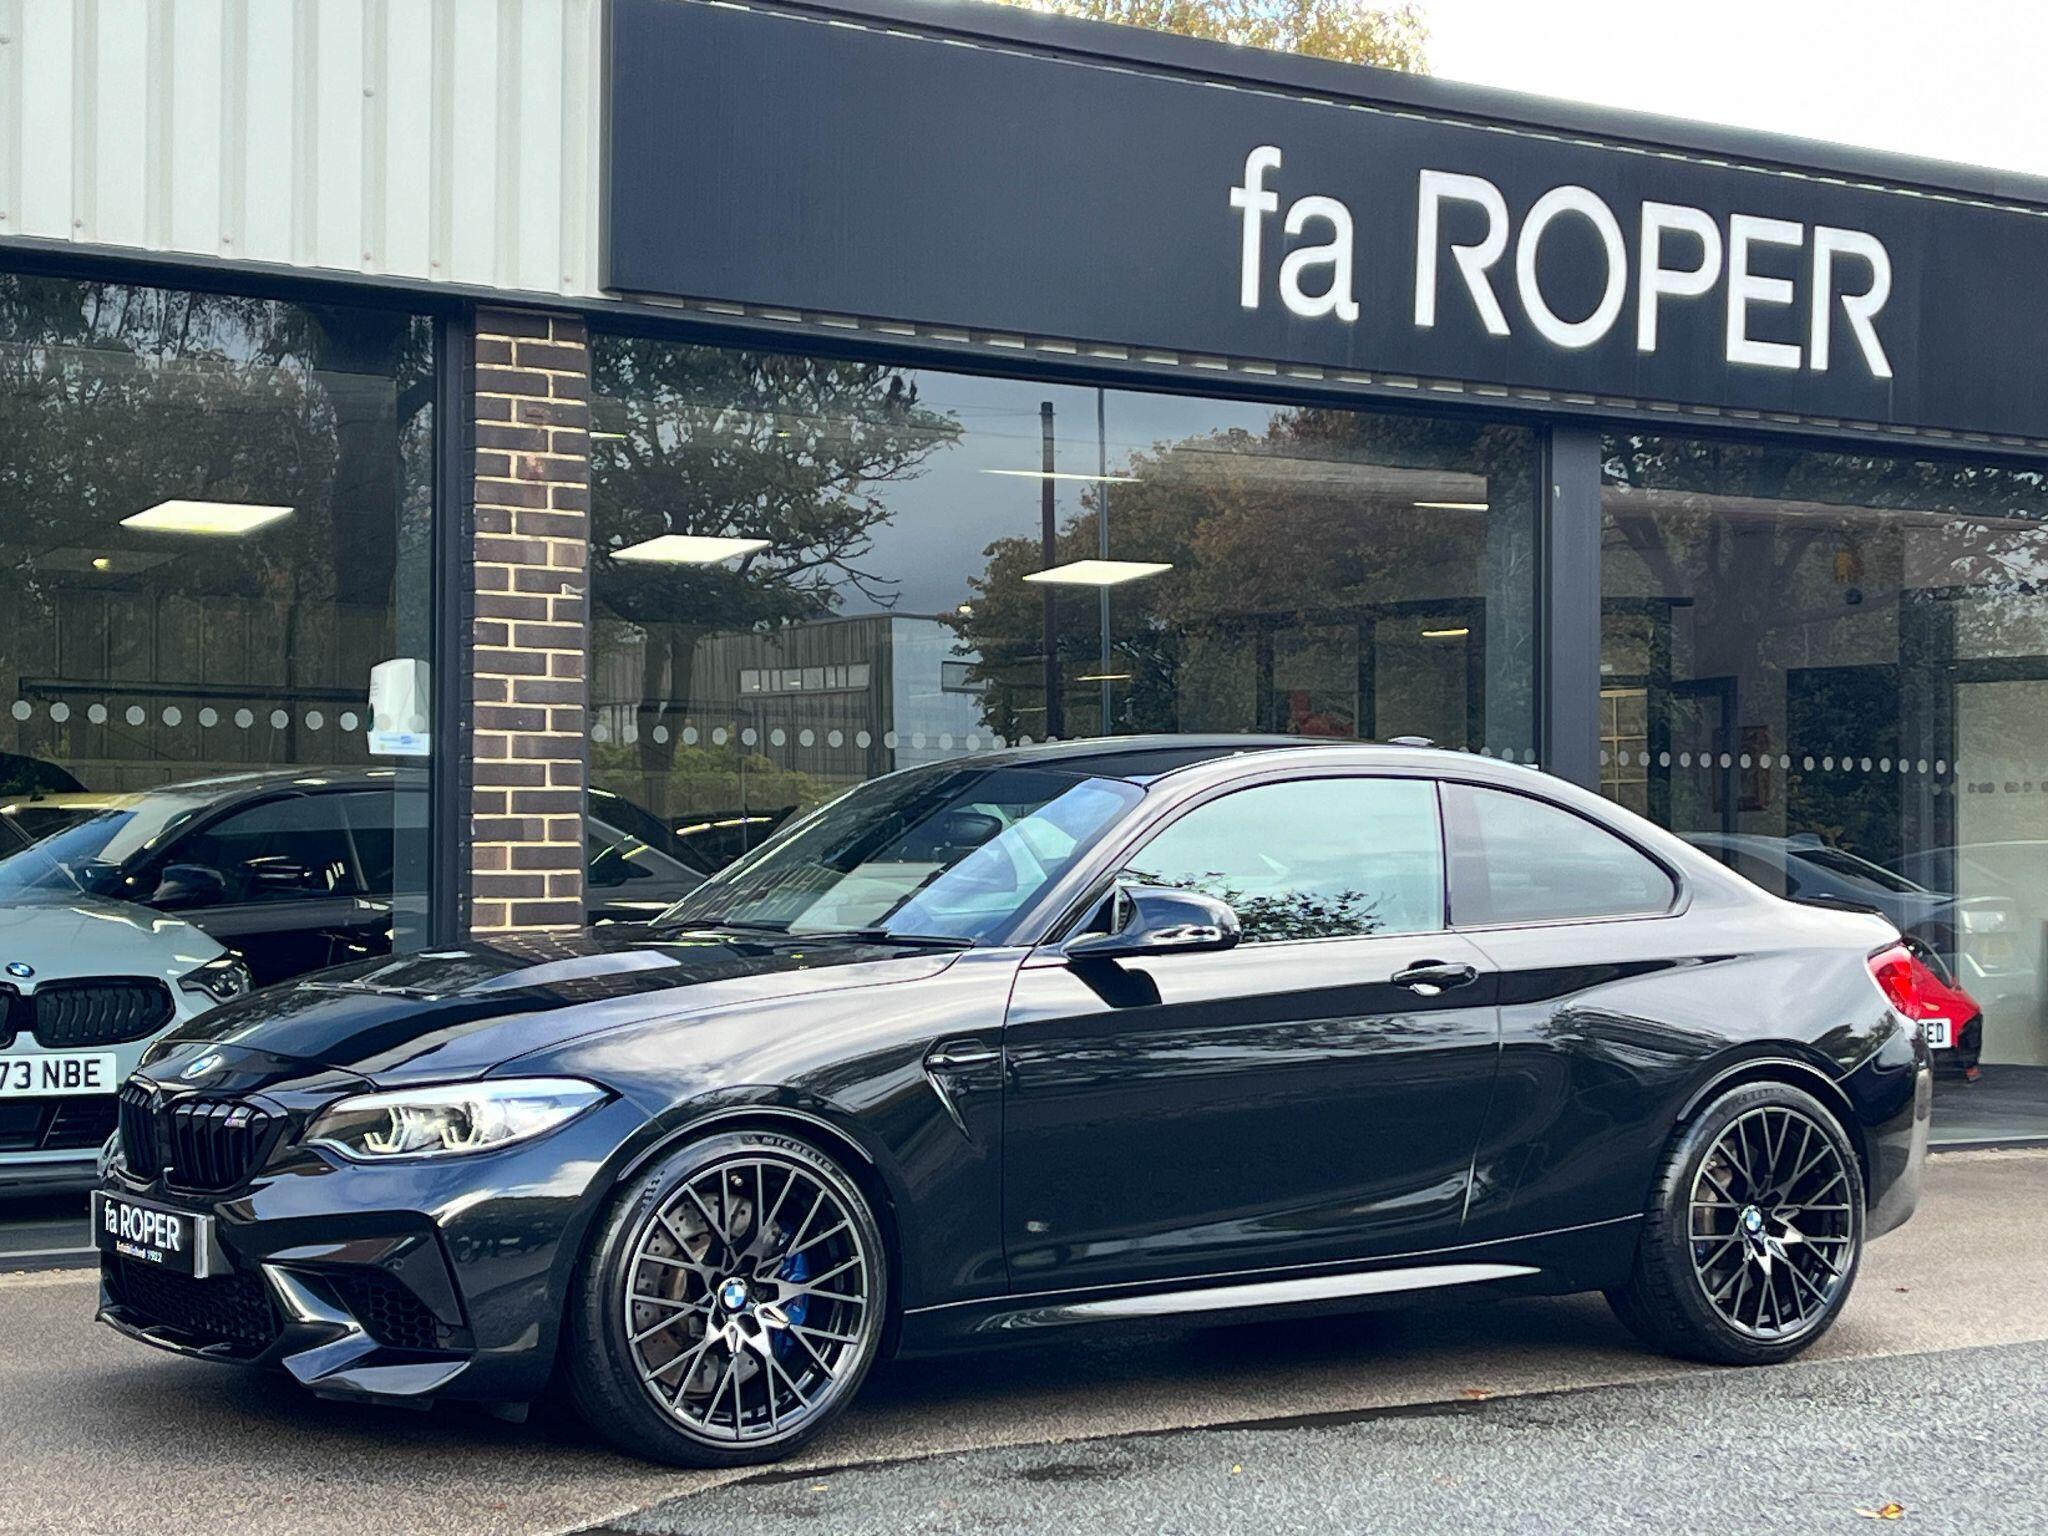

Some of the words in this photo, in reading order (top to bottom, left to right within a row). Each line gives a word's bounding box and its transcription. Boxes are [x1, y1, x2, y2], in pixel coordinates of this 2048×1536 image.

[1230, 145, 1360, 322] fa
[1414, 168, 1893, 378] ROPER
[42, 1059, 101, 1088] NBE
[761, 1136, 834, 1173] MICHELIN
[104, 1200, 118, 1234] fa
[120, 1203, 181, 1252] ROPER
